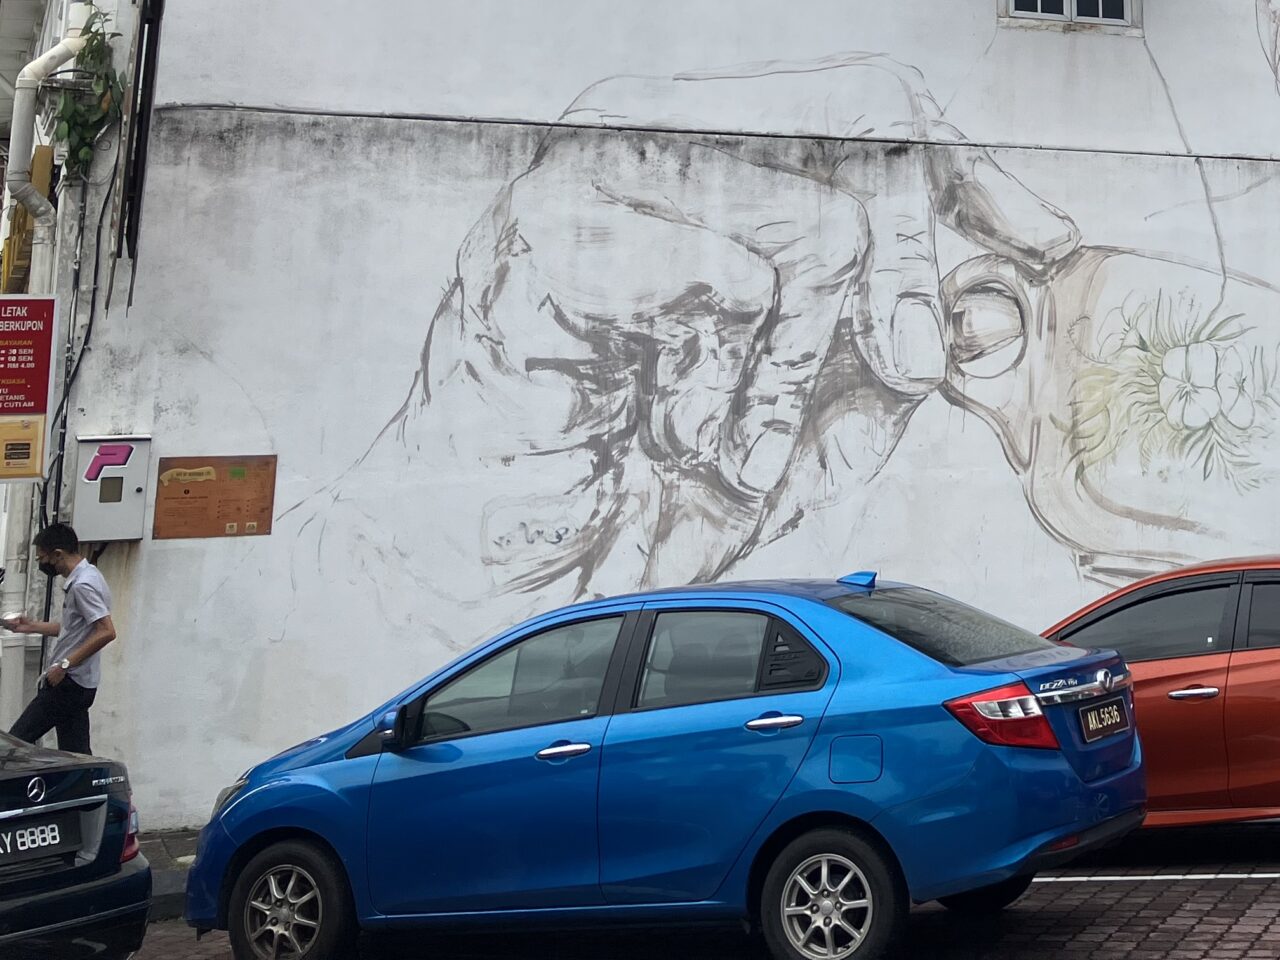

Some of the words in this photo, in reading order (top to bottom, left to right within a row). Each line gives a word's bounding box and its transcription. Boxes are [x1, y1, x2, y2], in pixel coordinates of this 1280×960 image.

[1, 306, 28, 317] LETAK
[1087, 705, 1120, 730] AKL5636
[16, 824, 60, 850] 8888
